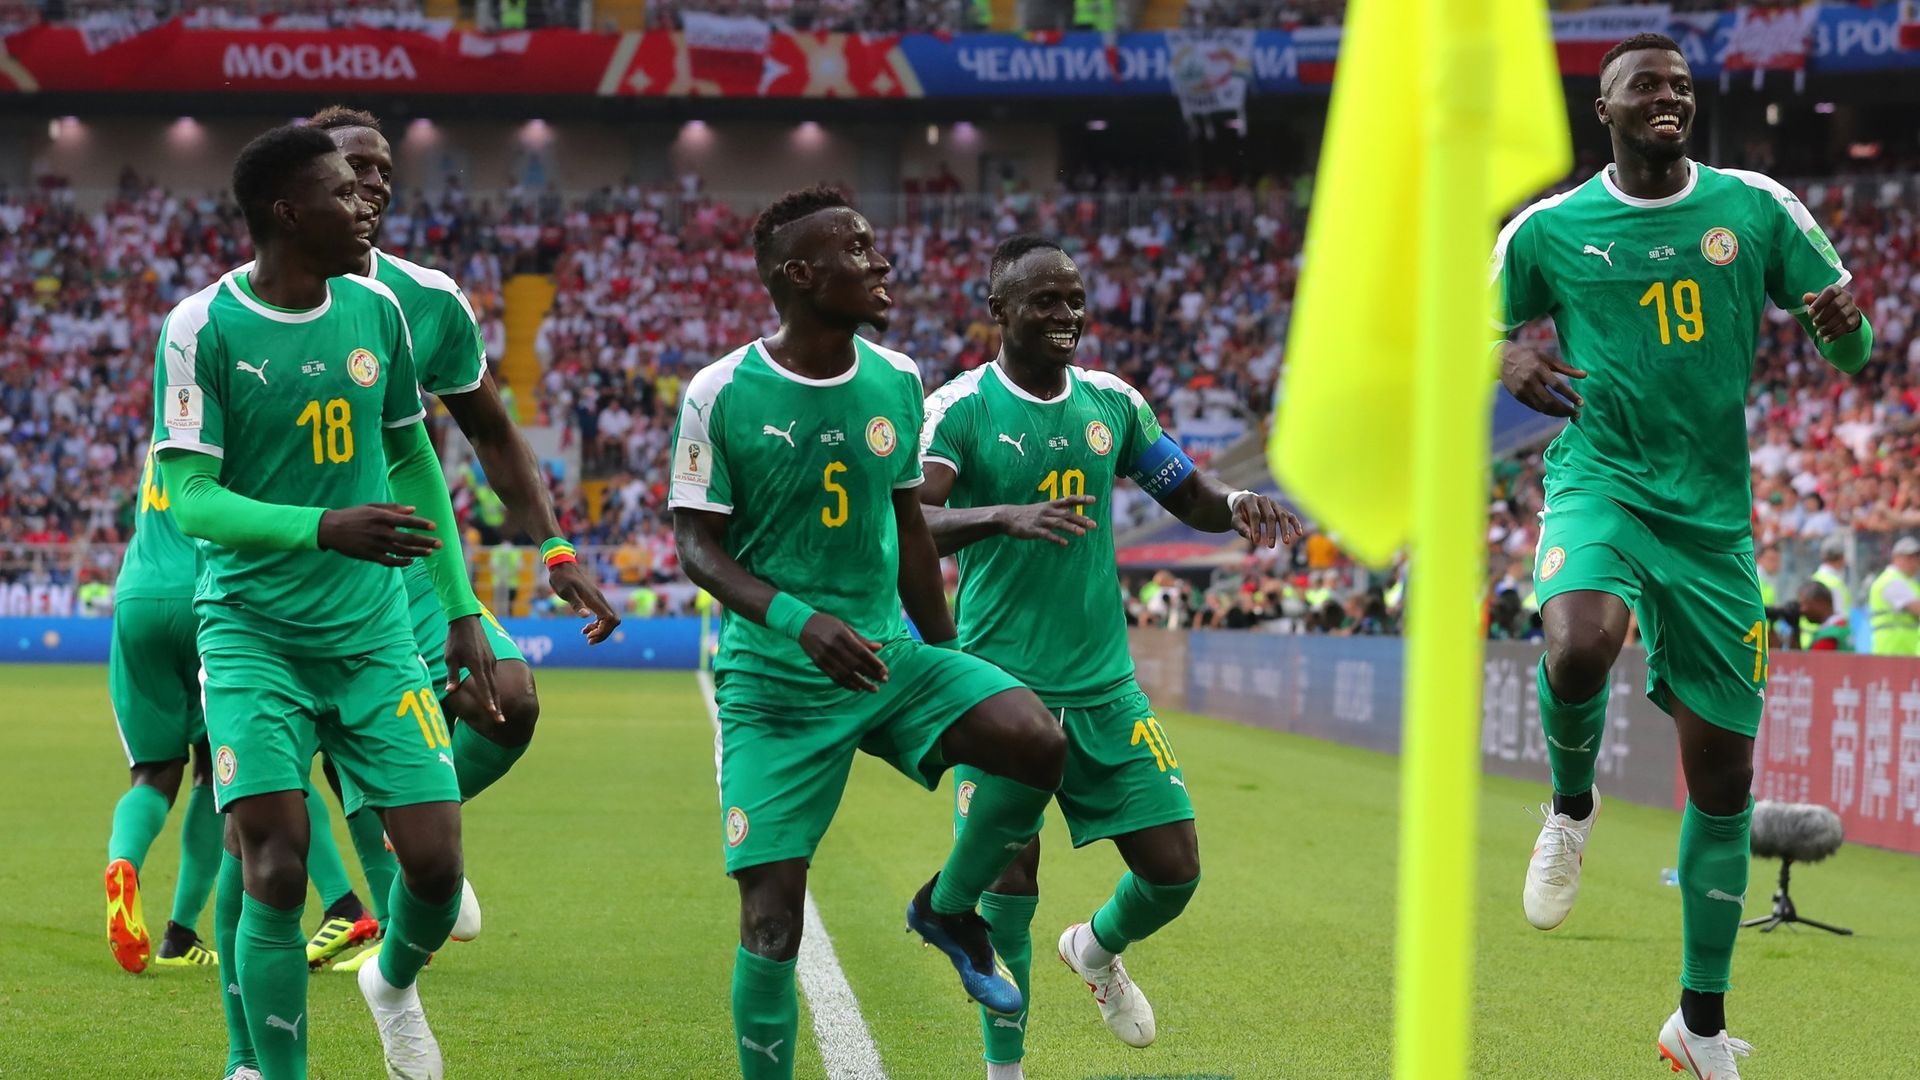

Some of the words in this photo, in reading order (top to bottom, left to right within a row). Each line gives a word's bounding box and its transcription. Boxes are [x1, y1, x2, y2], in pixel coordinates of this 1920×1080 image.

[222, 43, 417, 80] МОСКВА
[957, 47, 1169, 81] ЧЕМПИОН
[1639, 278, 1705, 346] 19
[296, 397, 355, 465] 18
[821, 460, 848, 529] 5
[1037, 468, 1086, 518] 10
[396, 687, 452, 750] 18
[1130, 716, 1178, 773] 10
